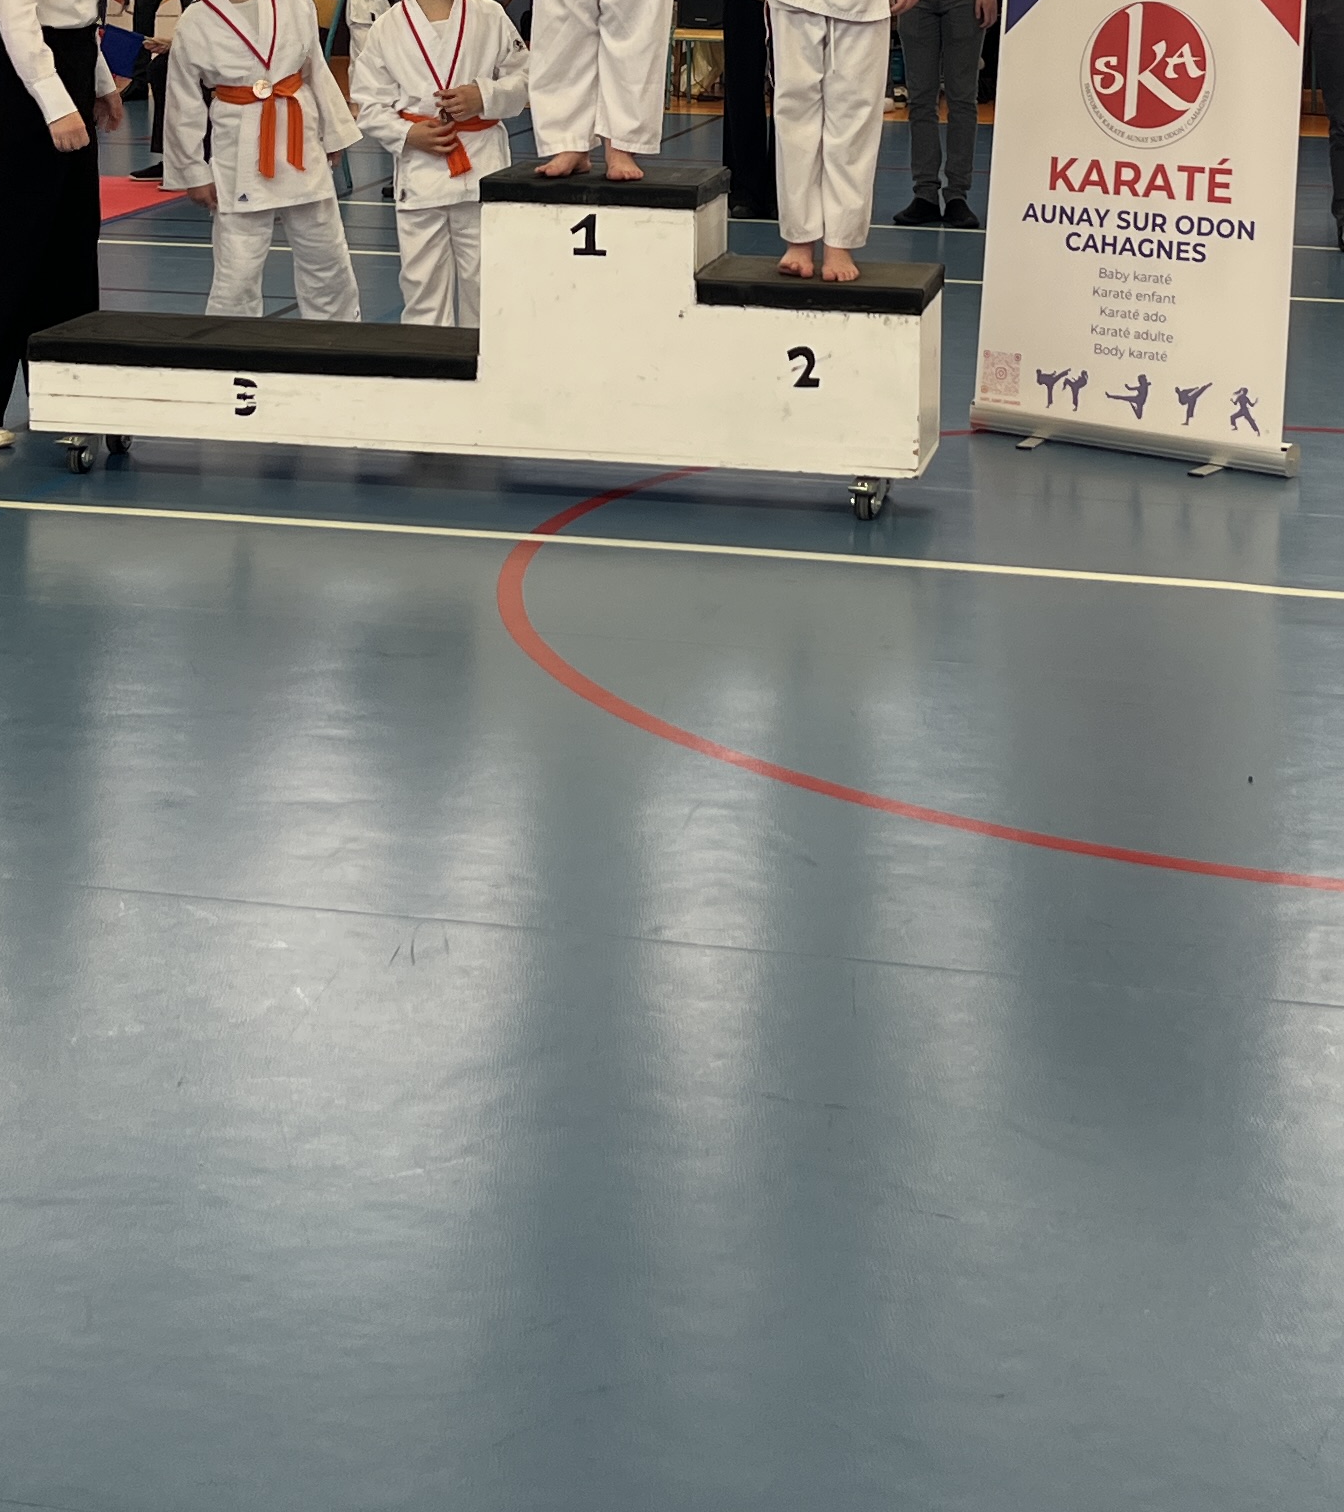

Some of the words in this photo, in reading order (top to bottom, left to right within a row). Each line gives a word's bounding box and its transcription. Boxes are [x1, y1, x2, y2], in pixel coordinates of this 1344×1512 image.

[1049, 156, 1233, 204] KARATÉ
[1022, 203, 1110, 228] AUNAY
[1116, 210, 1167, 233] SUR
[1175, 215, 1255, 240] ODON
[570, 214, 607, 256] 1
[1065, 232, 1206, 263] CAHAGNES
[1098, 267, 1130, 283] Baby
[1133, 271, 1173, 285] karaté
[1092, 286, 1133, 301] Karaté
[1135, 291, 1176, 304] enfant
[1099, 306, 1140, 320] Karaté
[1142, 311, 1167, 323] ado
[1090, 324, 1131, 339] Karaté
[1133, 329, 1174, 343] adulte
[1093, 343, 1126, 360] Body
[1128, 347, 1168, 362] karaté
[787, 346, 821, 388] 2
